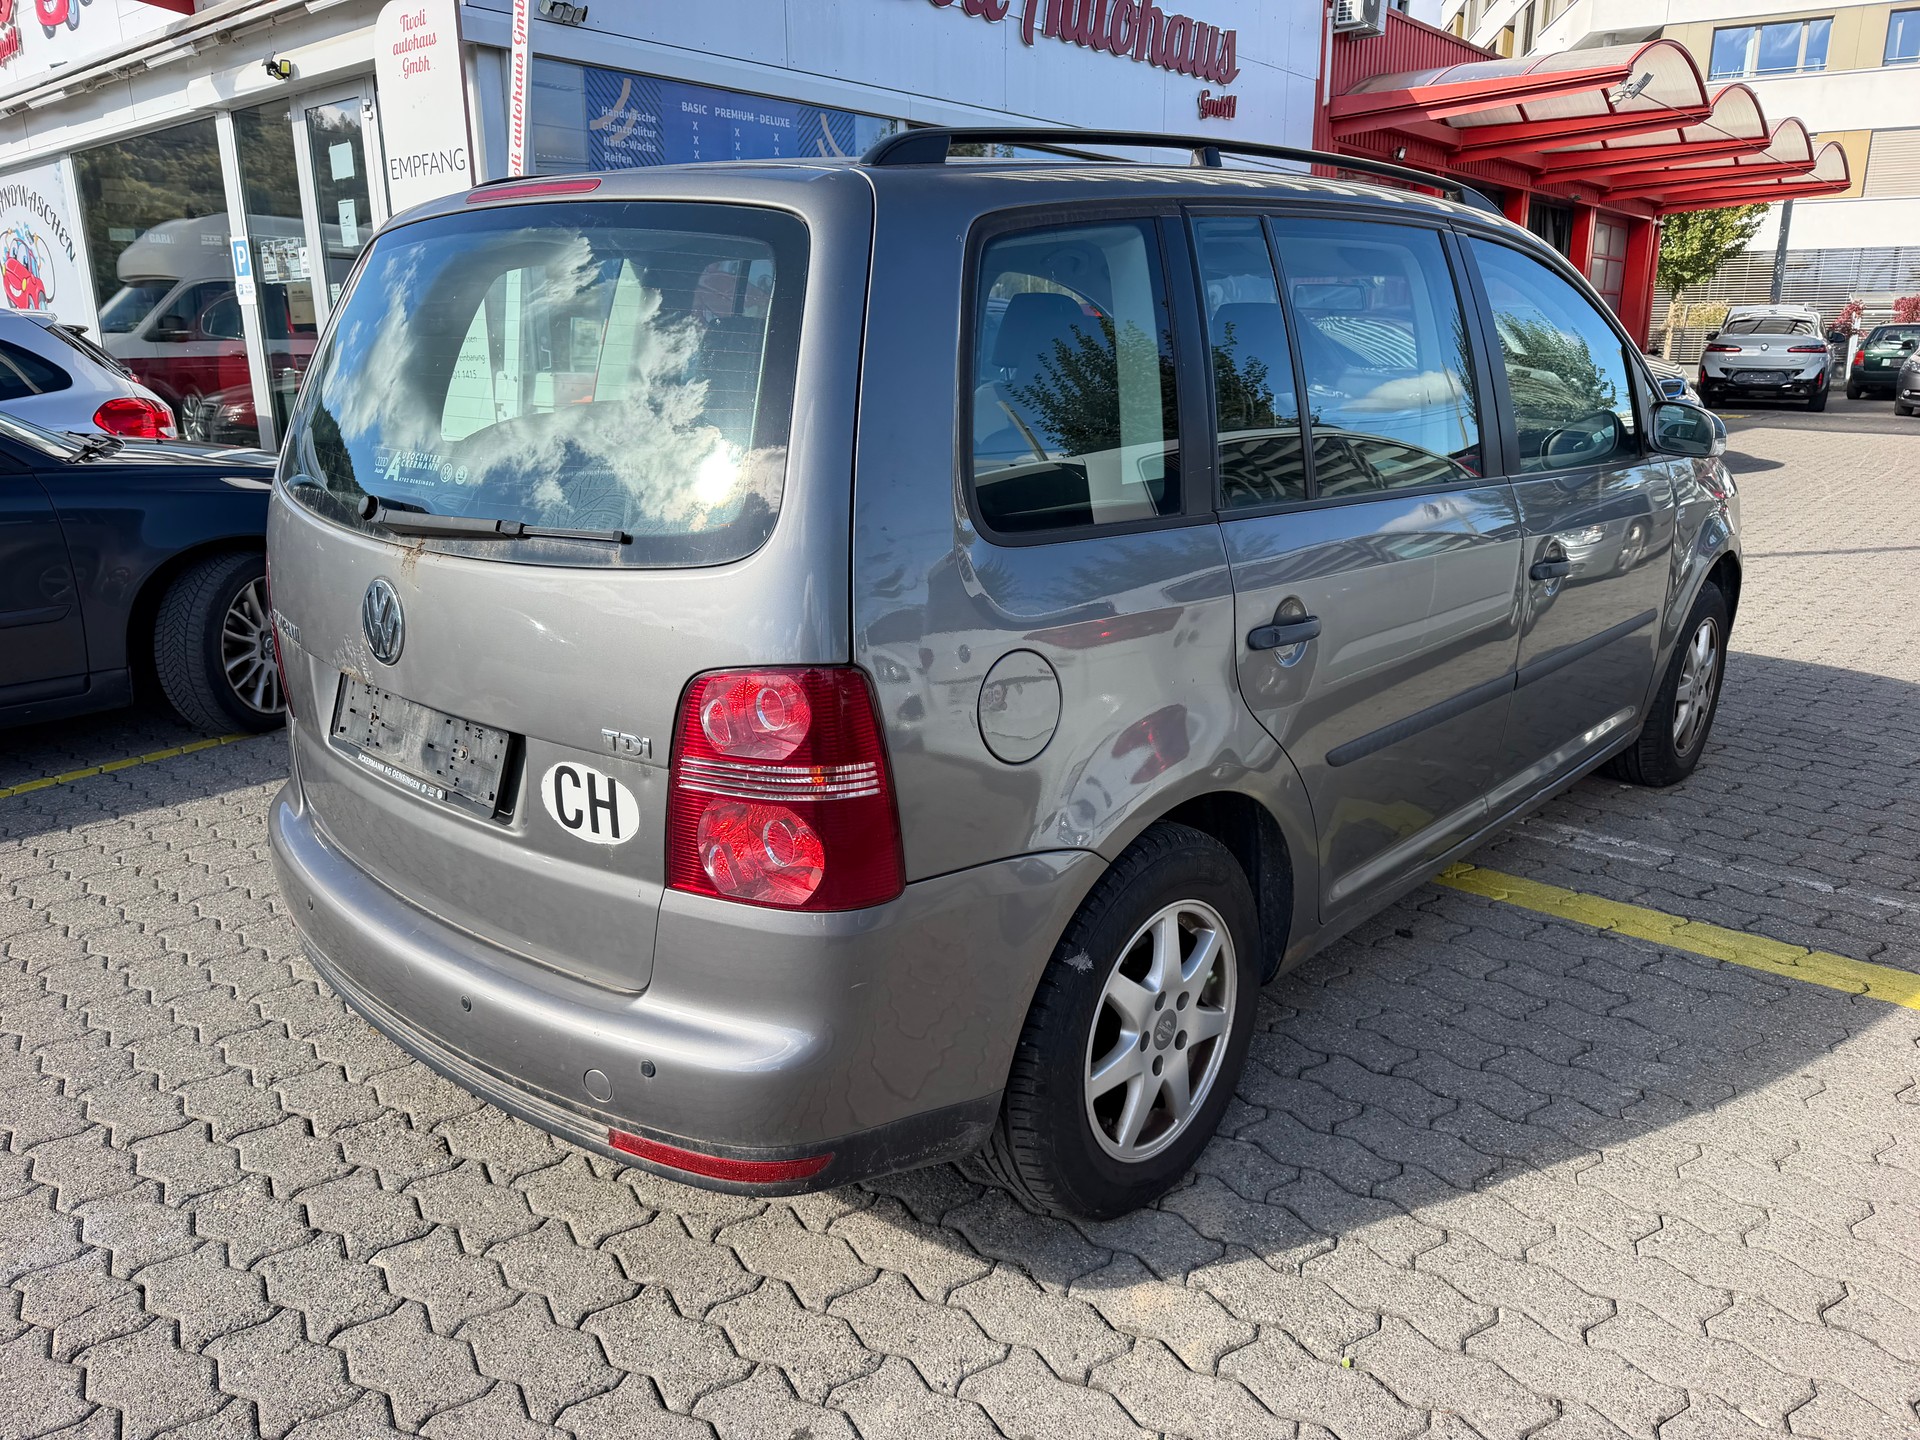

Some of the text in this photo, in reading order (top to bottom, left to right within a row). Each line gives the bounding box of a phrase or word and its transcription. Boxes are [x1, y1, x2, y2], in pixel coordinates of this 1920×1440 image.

[400, 9, 427, 32] Tivoli
[513, 0, 527, 46] Gmb
[393, 32, 438, 56] autohaus
[402, 55, 431, 80] Gmbh
[512, 52, 524, 149] autohaus
[682, 102, 791, 128] BASIC PREMIUM DELUXE
[1198, 89, 1238, 119] GmbH
[601, 105, 779, 142] Handwäsche X X X
[602, 121, 780, 156] Glanzpolitur X X X
[603, 136, 700, 160] Nano-Wachs X
[604, 151, 632, 165] Reifen
[390, 148, 466, 180] EMPFANG
[236, 246, 247, 273] P
[601, 728, 652, 759] TDI
[358, 753, 421, 790] ACKERMANN AG OENSINGEN
[554, 765, 620, 839] CH
